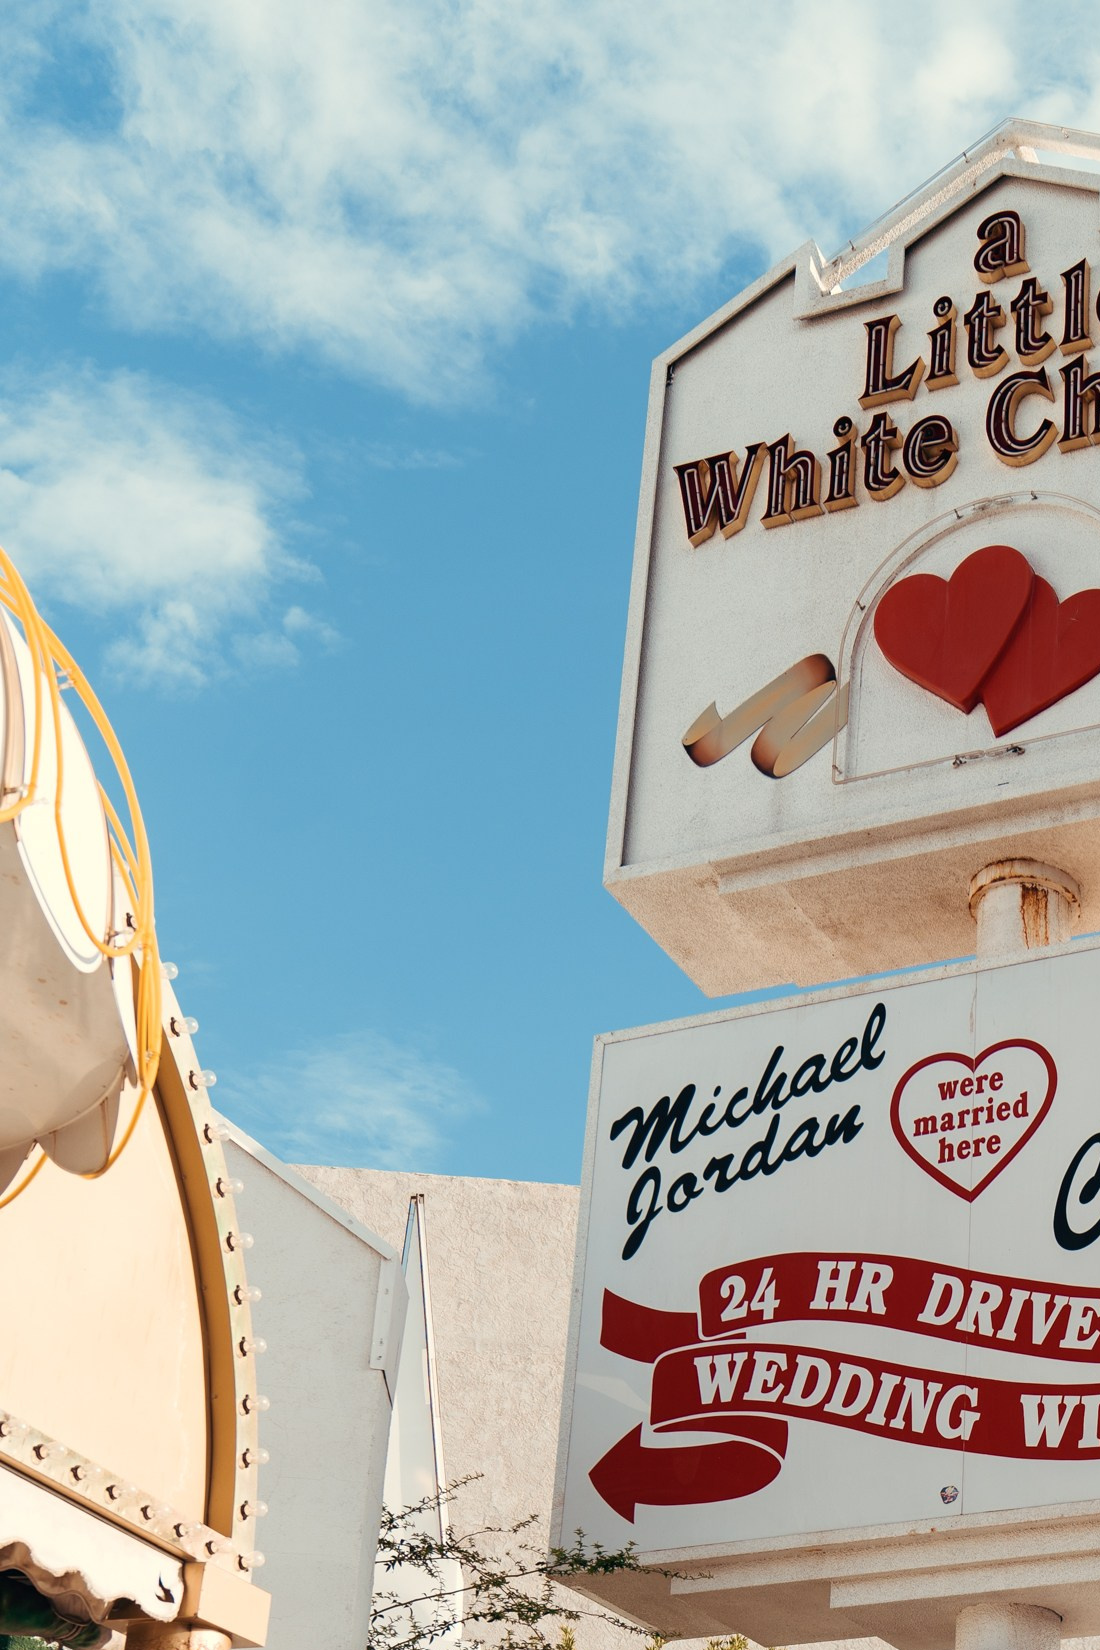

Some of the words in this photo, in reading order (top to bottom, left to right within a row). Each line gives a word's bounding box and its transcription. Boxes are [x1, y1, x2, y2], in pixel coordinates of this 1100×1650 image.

[975, 209, 1028, 282] a
[674, 412, 958, 546] White
[609, 1002, 887, 1170] Michael
[912, 1090, 1029, 1138] married
[937, 1071, 1004, 1101] were
[621, 1104, 864, 1261] Jordan
[937, 1134, 1002, 1164] here
[718, 1266, 781, 1323] 24
[808, 1260, 896, 1317] HR
[692, 1350, 982, 1443] WEDDING
